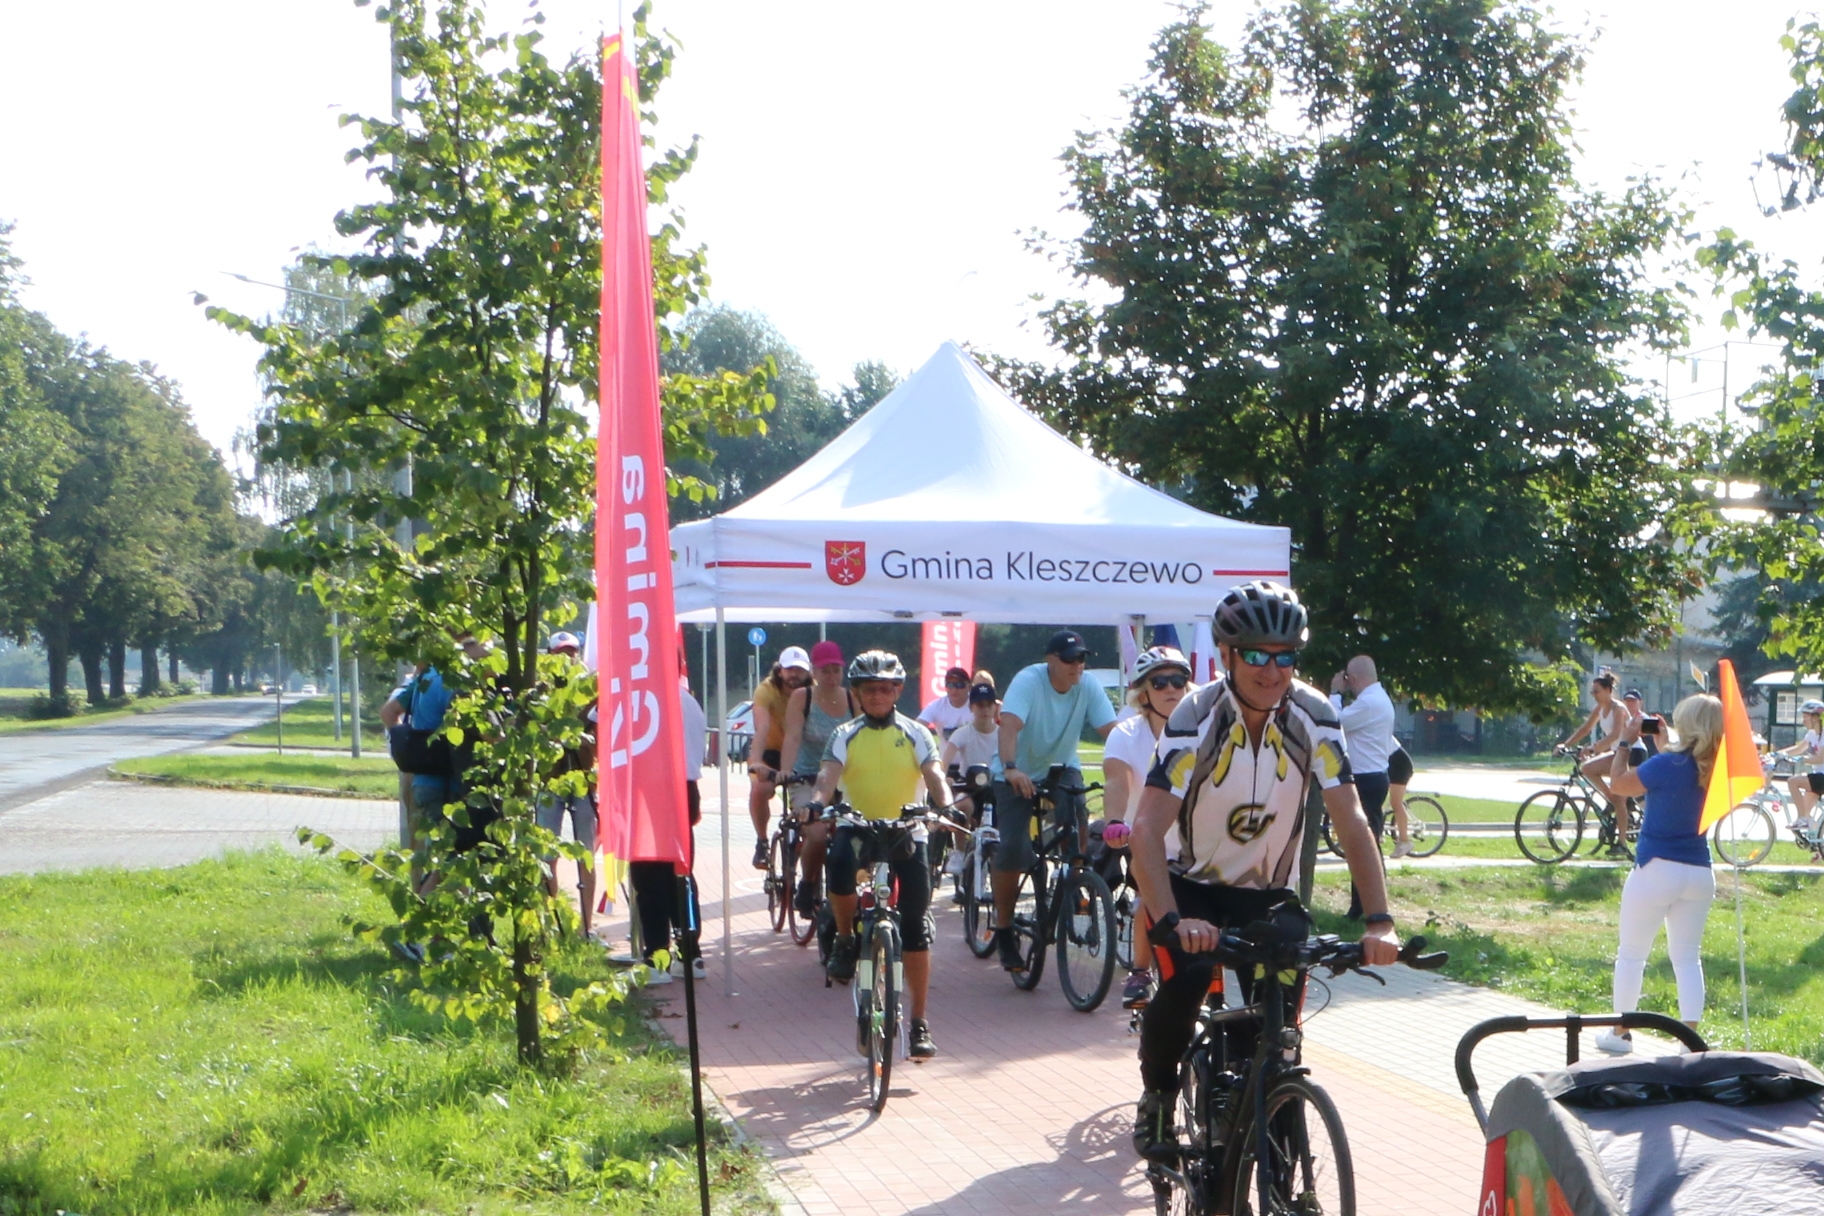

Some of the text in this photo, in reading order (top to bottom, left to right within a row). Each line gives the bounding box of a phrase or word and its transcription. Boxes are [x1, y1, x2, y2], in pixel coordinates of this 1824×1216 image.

[880, 549, 1203, 584] Gmina Kleszczewo
[929, 620, 948, 698] Gmin
